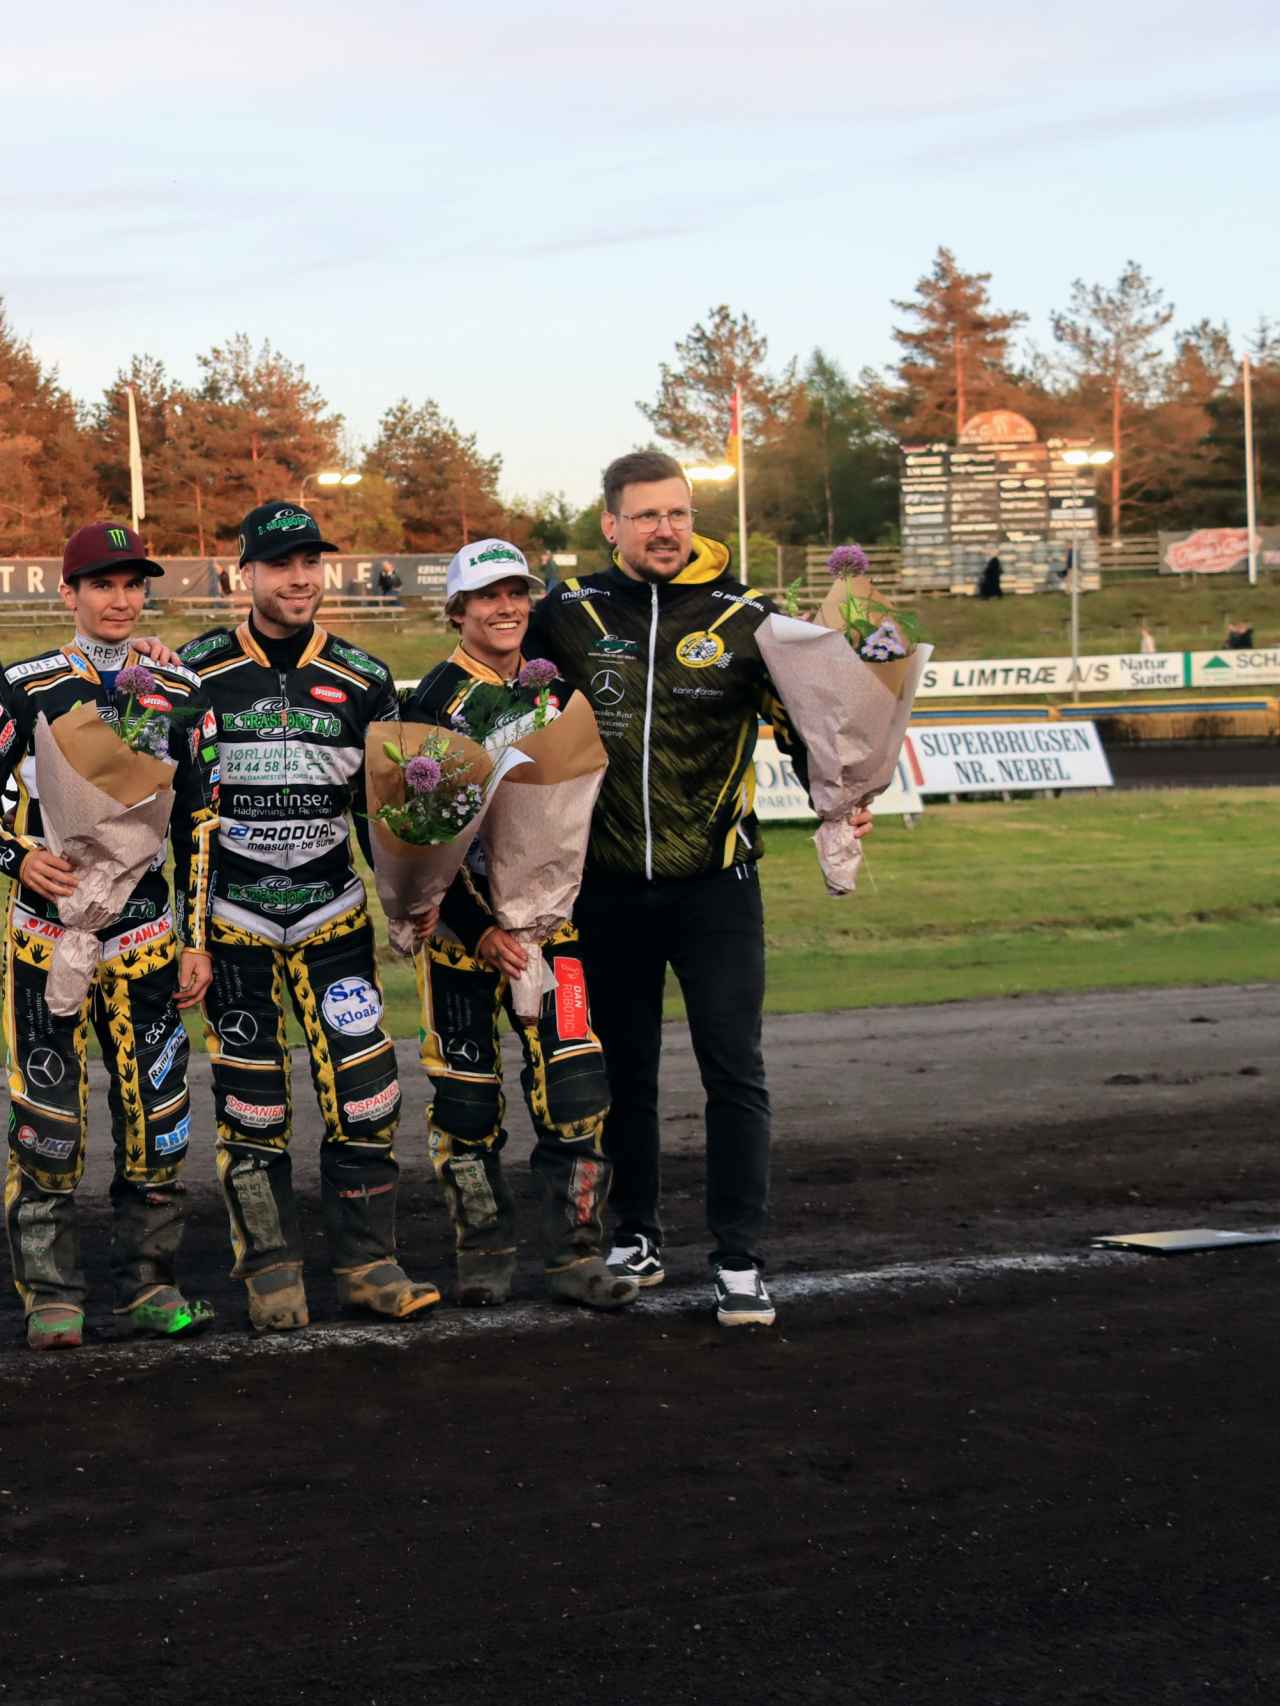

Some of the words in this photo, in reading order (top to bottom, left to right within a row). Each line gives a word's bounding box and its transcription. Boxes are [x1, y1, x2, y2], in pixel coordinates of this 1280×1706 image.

[952, 666, 1056, 687] LIMTRÆ
[920, 727, 1090, 757] SUPERBRUGSEN
[227, 762, 241, 773] 24
[244, 762, 259, 773] 44
[264, 761, 279, 773] 58
[955, 759, 995, 785] NR.
[997, 757, 1071, 784] NEBEL
[250, 823, 336, 841] PRODUAL
[335, 1003, 378, 1027] Kloak
